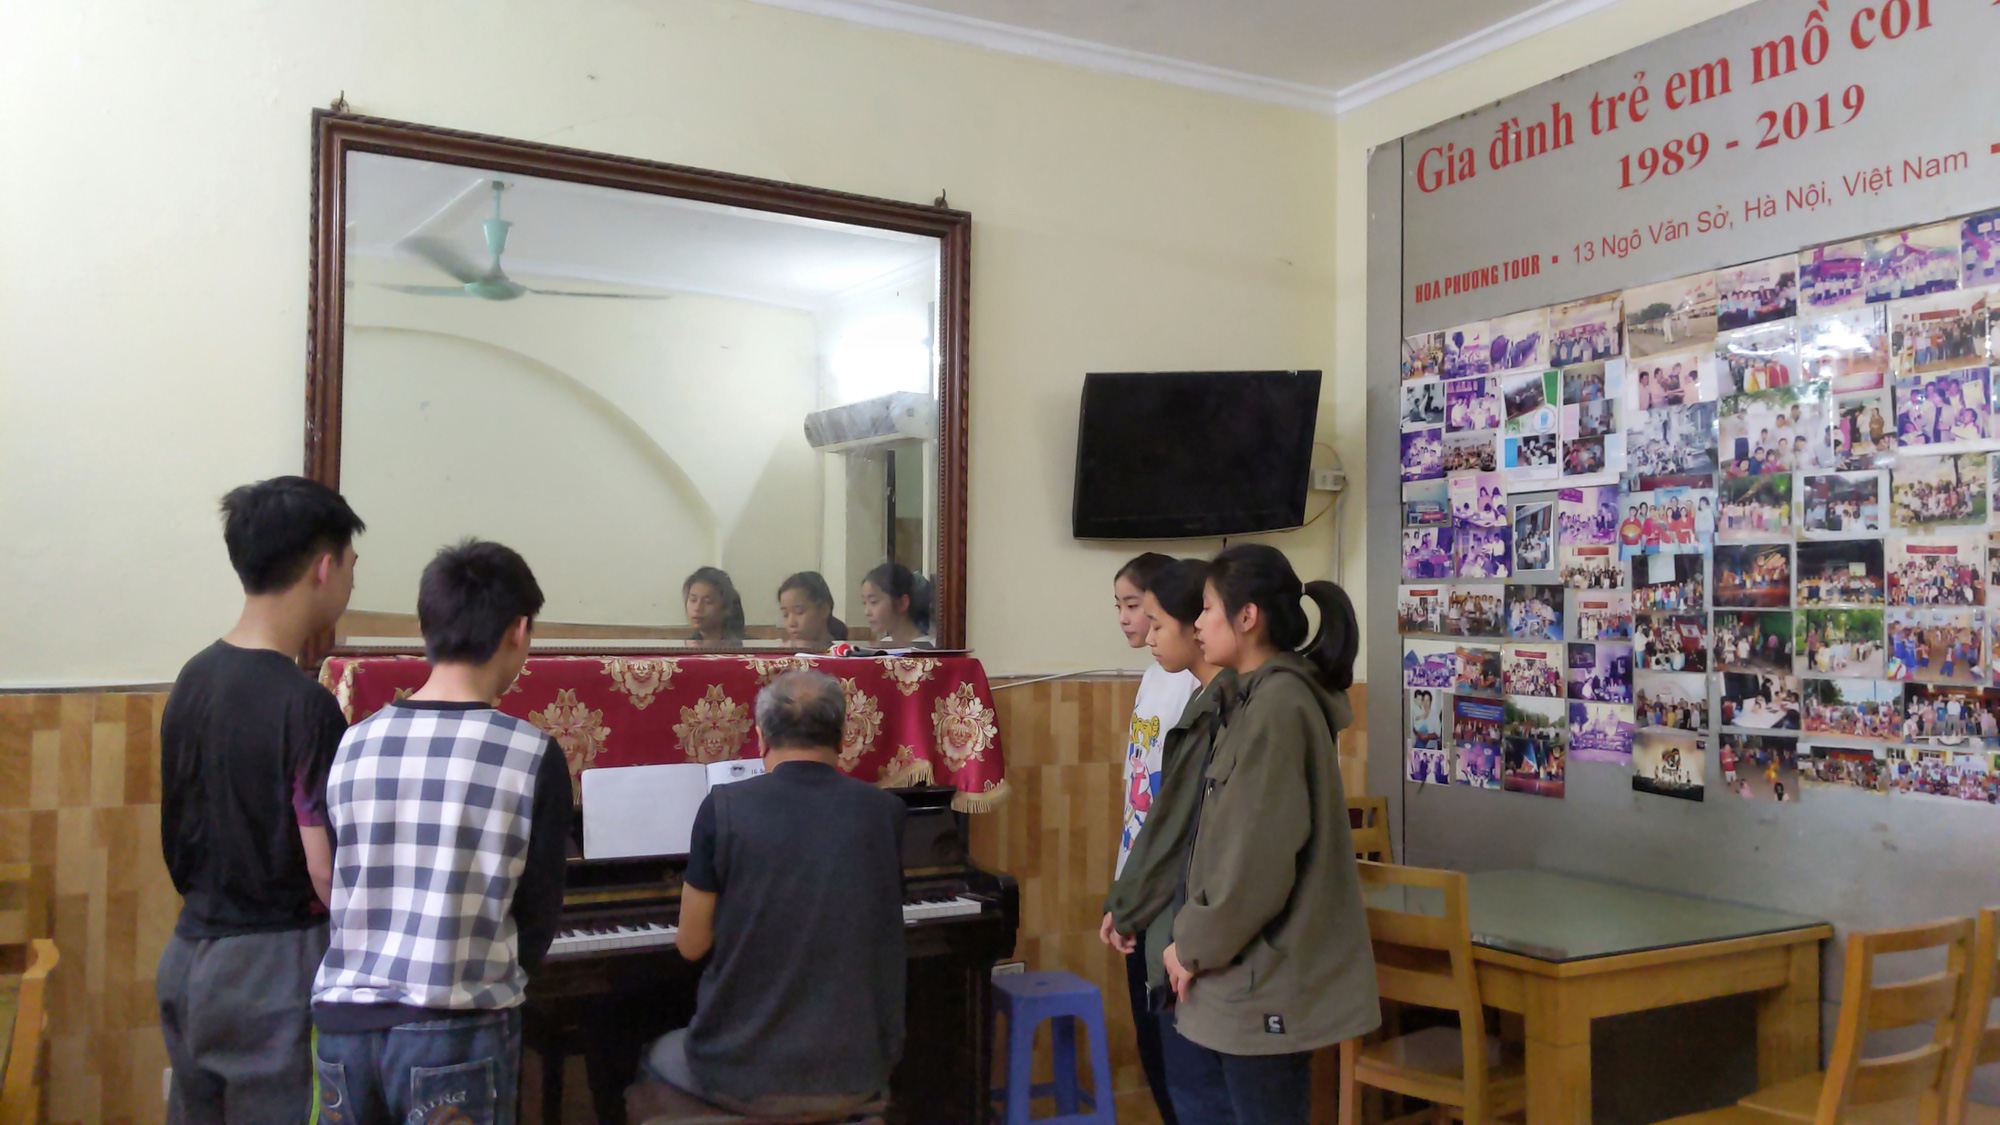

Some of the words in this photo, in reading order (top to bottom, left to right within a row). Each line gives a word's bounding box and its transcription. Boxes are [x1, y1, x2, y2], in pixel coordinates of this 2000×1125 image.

[1416, 142, 1476, 194] Gia
[1489, 101, 1574, 170] đình
[1588, 71, 1649, 136] trẻ
[1664, 57, 1732, 110] em
[1751, 0, 1830, 84] mồ
[1617, 132, 1710, 190] 1989
[1755, 84, 1865, 150] 2019
[1415, 280, 1441, 304] HOA
[1502, 254, 1540, 282] TOUR
[1573, 241, 1595, 263] 13
[1601, 229, 1642, 258] Ngô
[1648, 219, 1689, 245] Văn
[1745, 195, 1777, 223] Hà
[1786, 181, 1832, 212] Nội,
[1843, 165, 1893, 197] Việt
[1903, 151, 1969, 184] Nam
